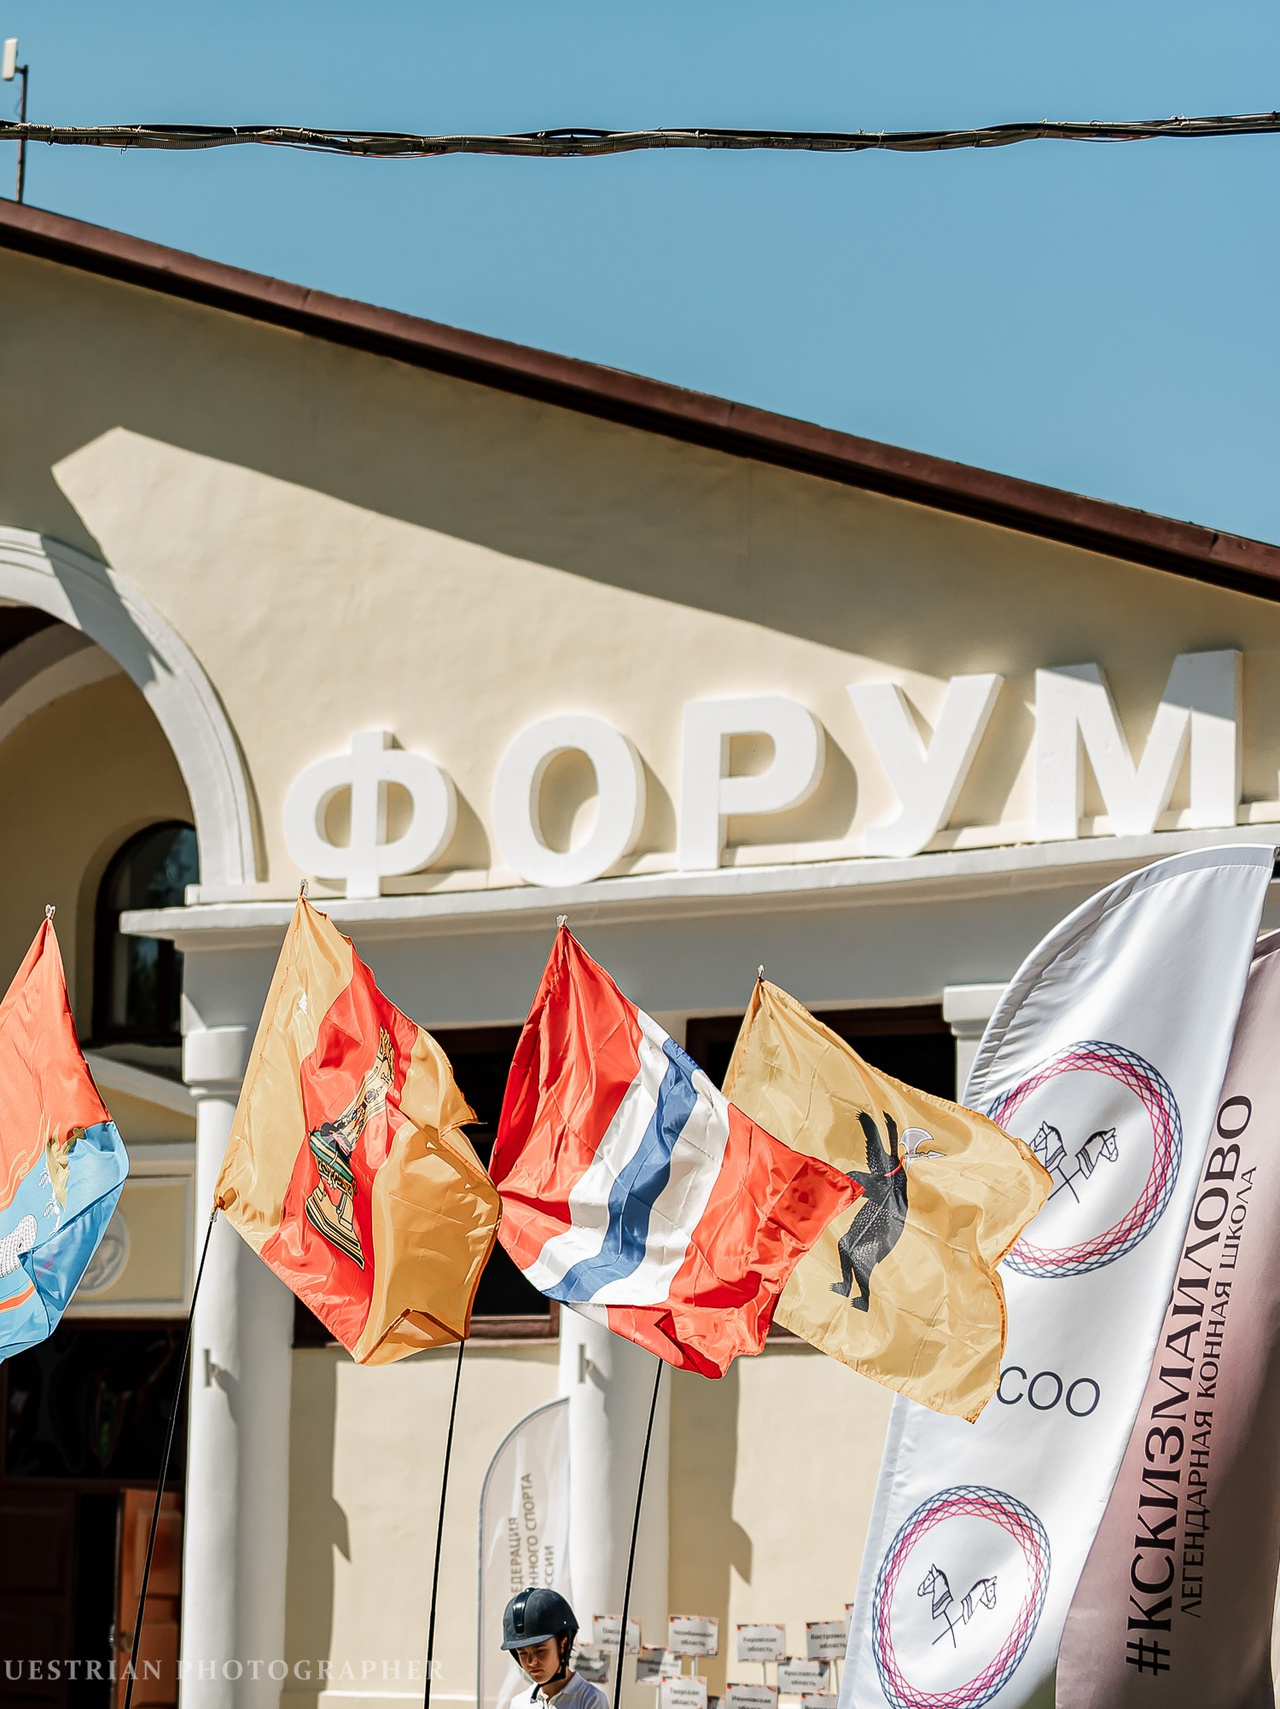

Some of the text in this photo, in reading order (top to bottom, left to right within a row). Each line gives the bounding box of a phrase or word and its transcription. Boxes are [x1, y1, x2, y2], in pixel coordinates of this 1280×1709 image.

[283, 649, 1242, 898] ФОРУМ
[1179, 1165, 1258, 1619] ЛЕГЕНДАРНАЯ КОННАЯ ШКОЛА
[509, 1517, 523, 1593] ЕДЕРАЦИЯ
[521, 1473, 539, 1585] ННОГО СПОРТА
[544, 1546, 554, 1588] ССИИ
